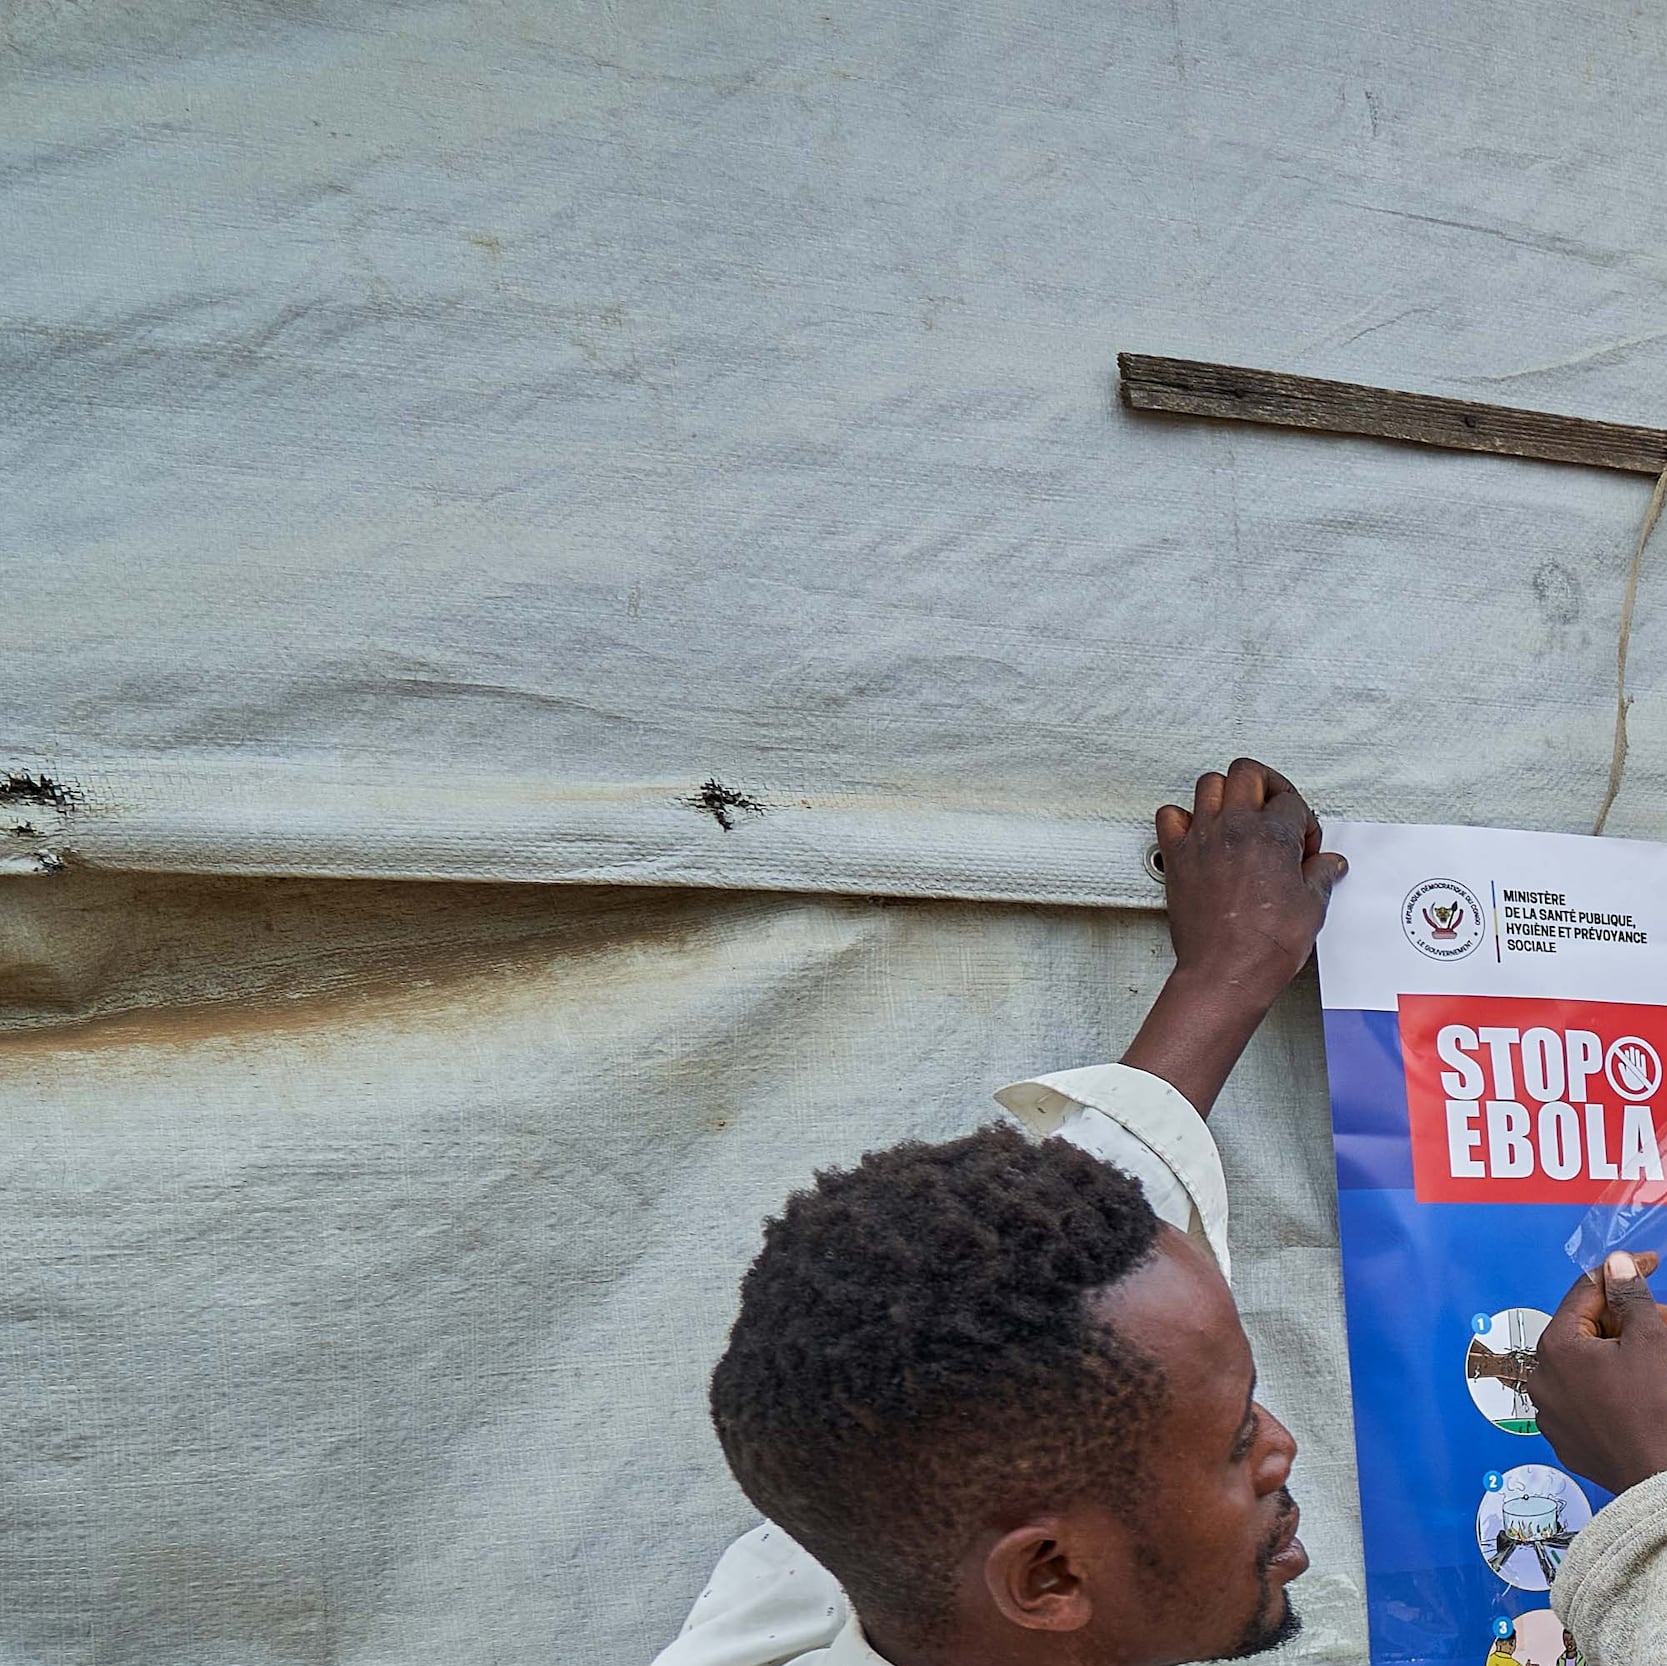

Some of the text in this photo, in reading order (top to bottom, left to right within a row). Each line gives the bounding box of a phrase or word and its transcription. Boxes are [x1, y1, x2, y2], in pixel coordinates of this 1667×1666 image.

[1503, 889, 1566, 906] MINISTÈRE
[1505, 906, 1636, 929] DE LA SANTÉ PUBLIQUE,
[1506, 922, 1648, 944] HYGIÈNE ET PRÉVOYANCE
[1507, 939, 1557, 953] SOCIALE
[1437, 1024, 1603, 1102] STOP
[1445, 1099, 1665, 1181] EBOLA
[1476, 1317, 1486, 1331] 1
[1488, 1474, 1497, 1488] 2
[1498, 1621, 1508, 1634] 3
